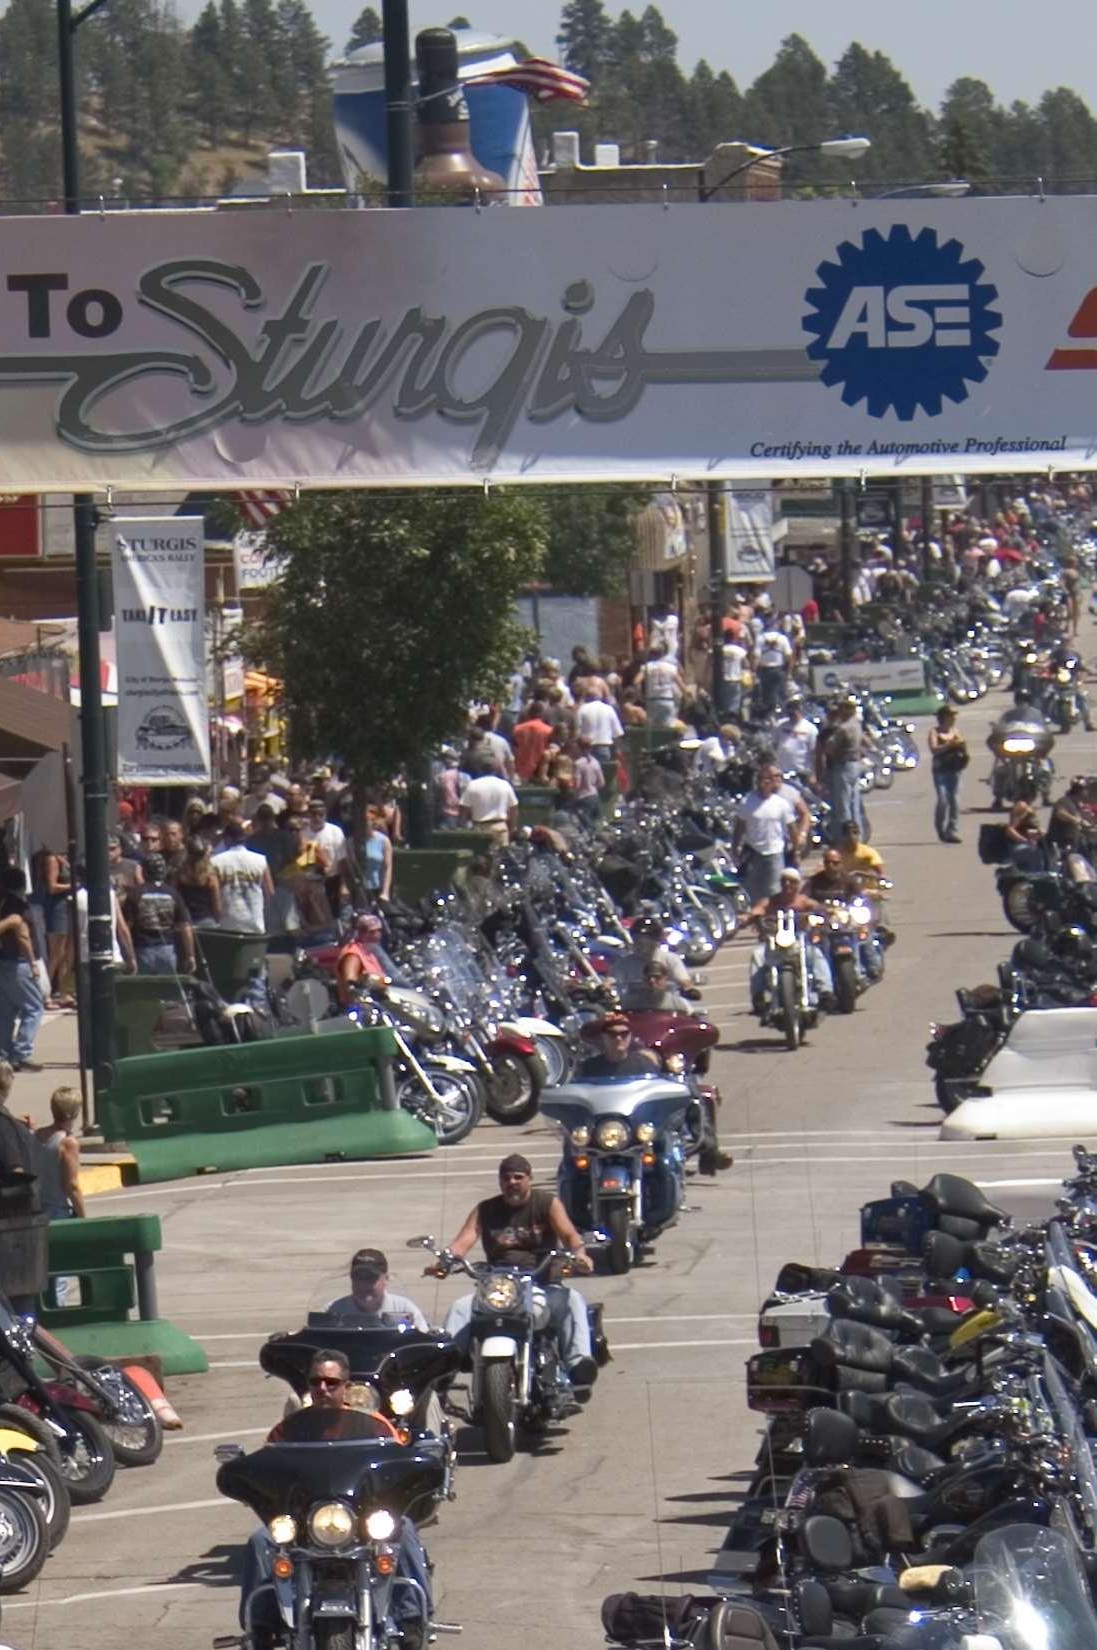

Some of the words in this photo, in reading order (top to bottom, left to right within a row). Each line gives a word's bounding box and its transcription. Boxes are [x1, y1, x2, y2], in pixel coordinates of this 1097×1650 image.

[6, 272, 124, 339] To
[826, 283, 972, 349] ASE
[55, 258, 656, 473] Sturgis
[750, 440, 832, 461] Certifying
[836, 440, 862, 456] the
[866, 438, 960, 456] Automotive
[964, 435, 1067, 454] Professional
[117, 537, 198, 552] STURGIS
